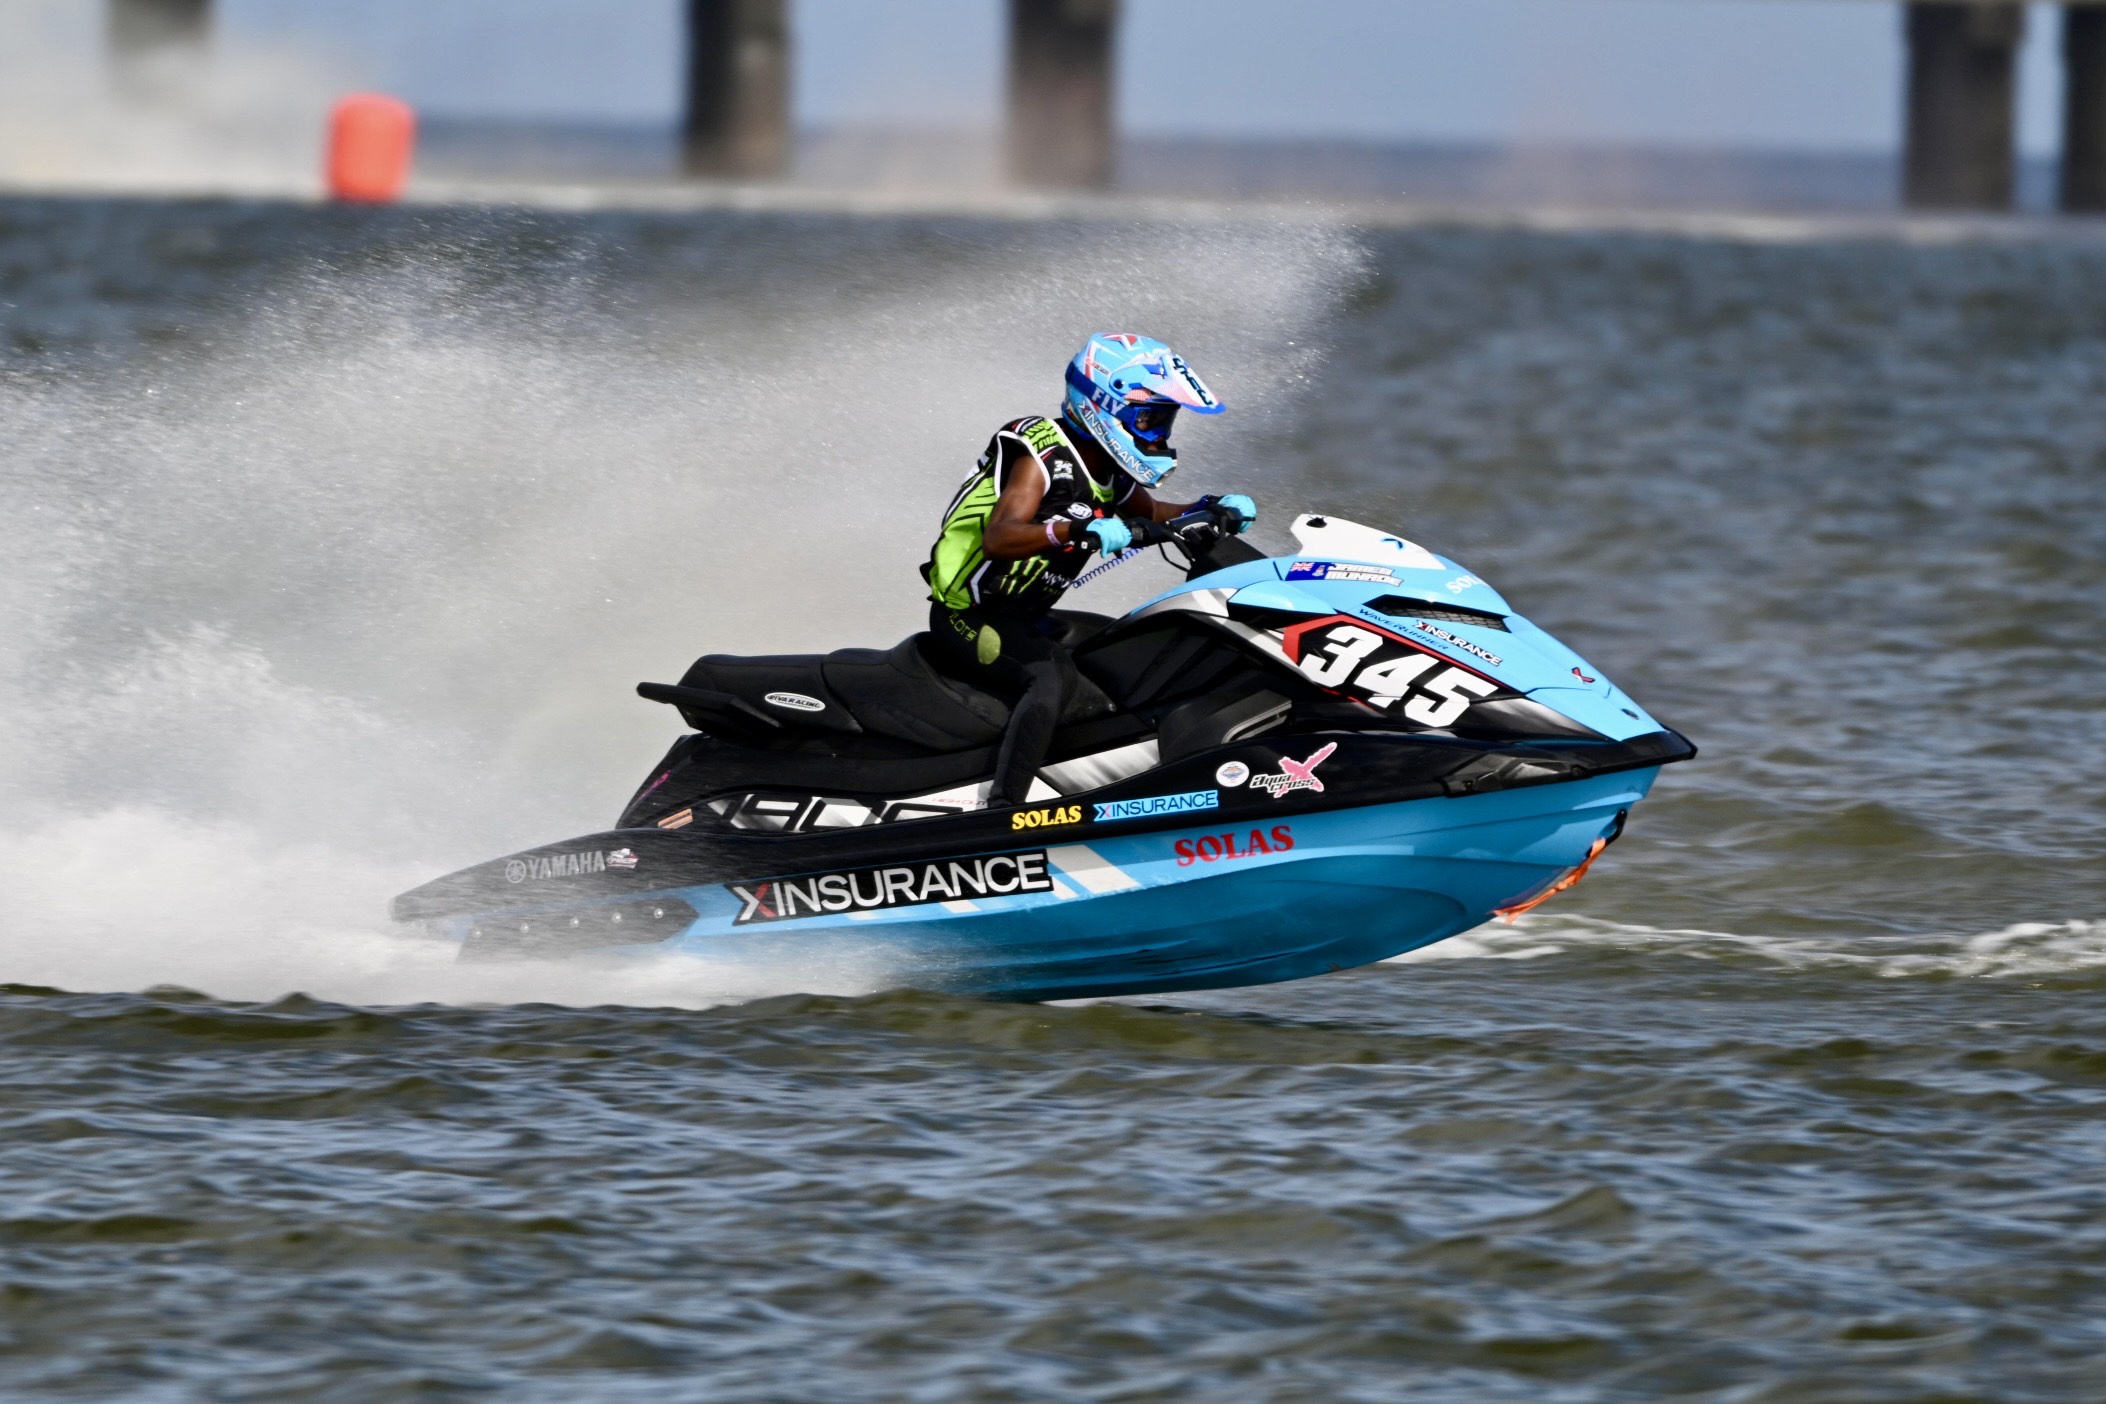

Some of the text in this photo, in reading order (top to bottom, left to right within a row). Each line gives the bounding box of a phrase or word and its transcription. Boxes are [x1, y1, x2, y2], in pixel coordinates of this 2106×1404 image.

[1091, 386, 1125, 416] FLY
[1078, 399, 1157, 482] XINSURANCE
[1446, 575, 1490, 594] SOL
[1359, 609, 1449, 650] WAVERUNNER
[1415, 620, 1503, 667] XINSURANCE
[1300, 625, 1498, 728] 345
[1011, 805, 1082, 830] SOLAS
[1096, 792, 1218, 820] XINSURANCE
[528, 851, 605, 880] YAMAHA
[1175, 825, 1295, 867] SOLAS
[733, 853, 1051, 921] XINSURANCE
